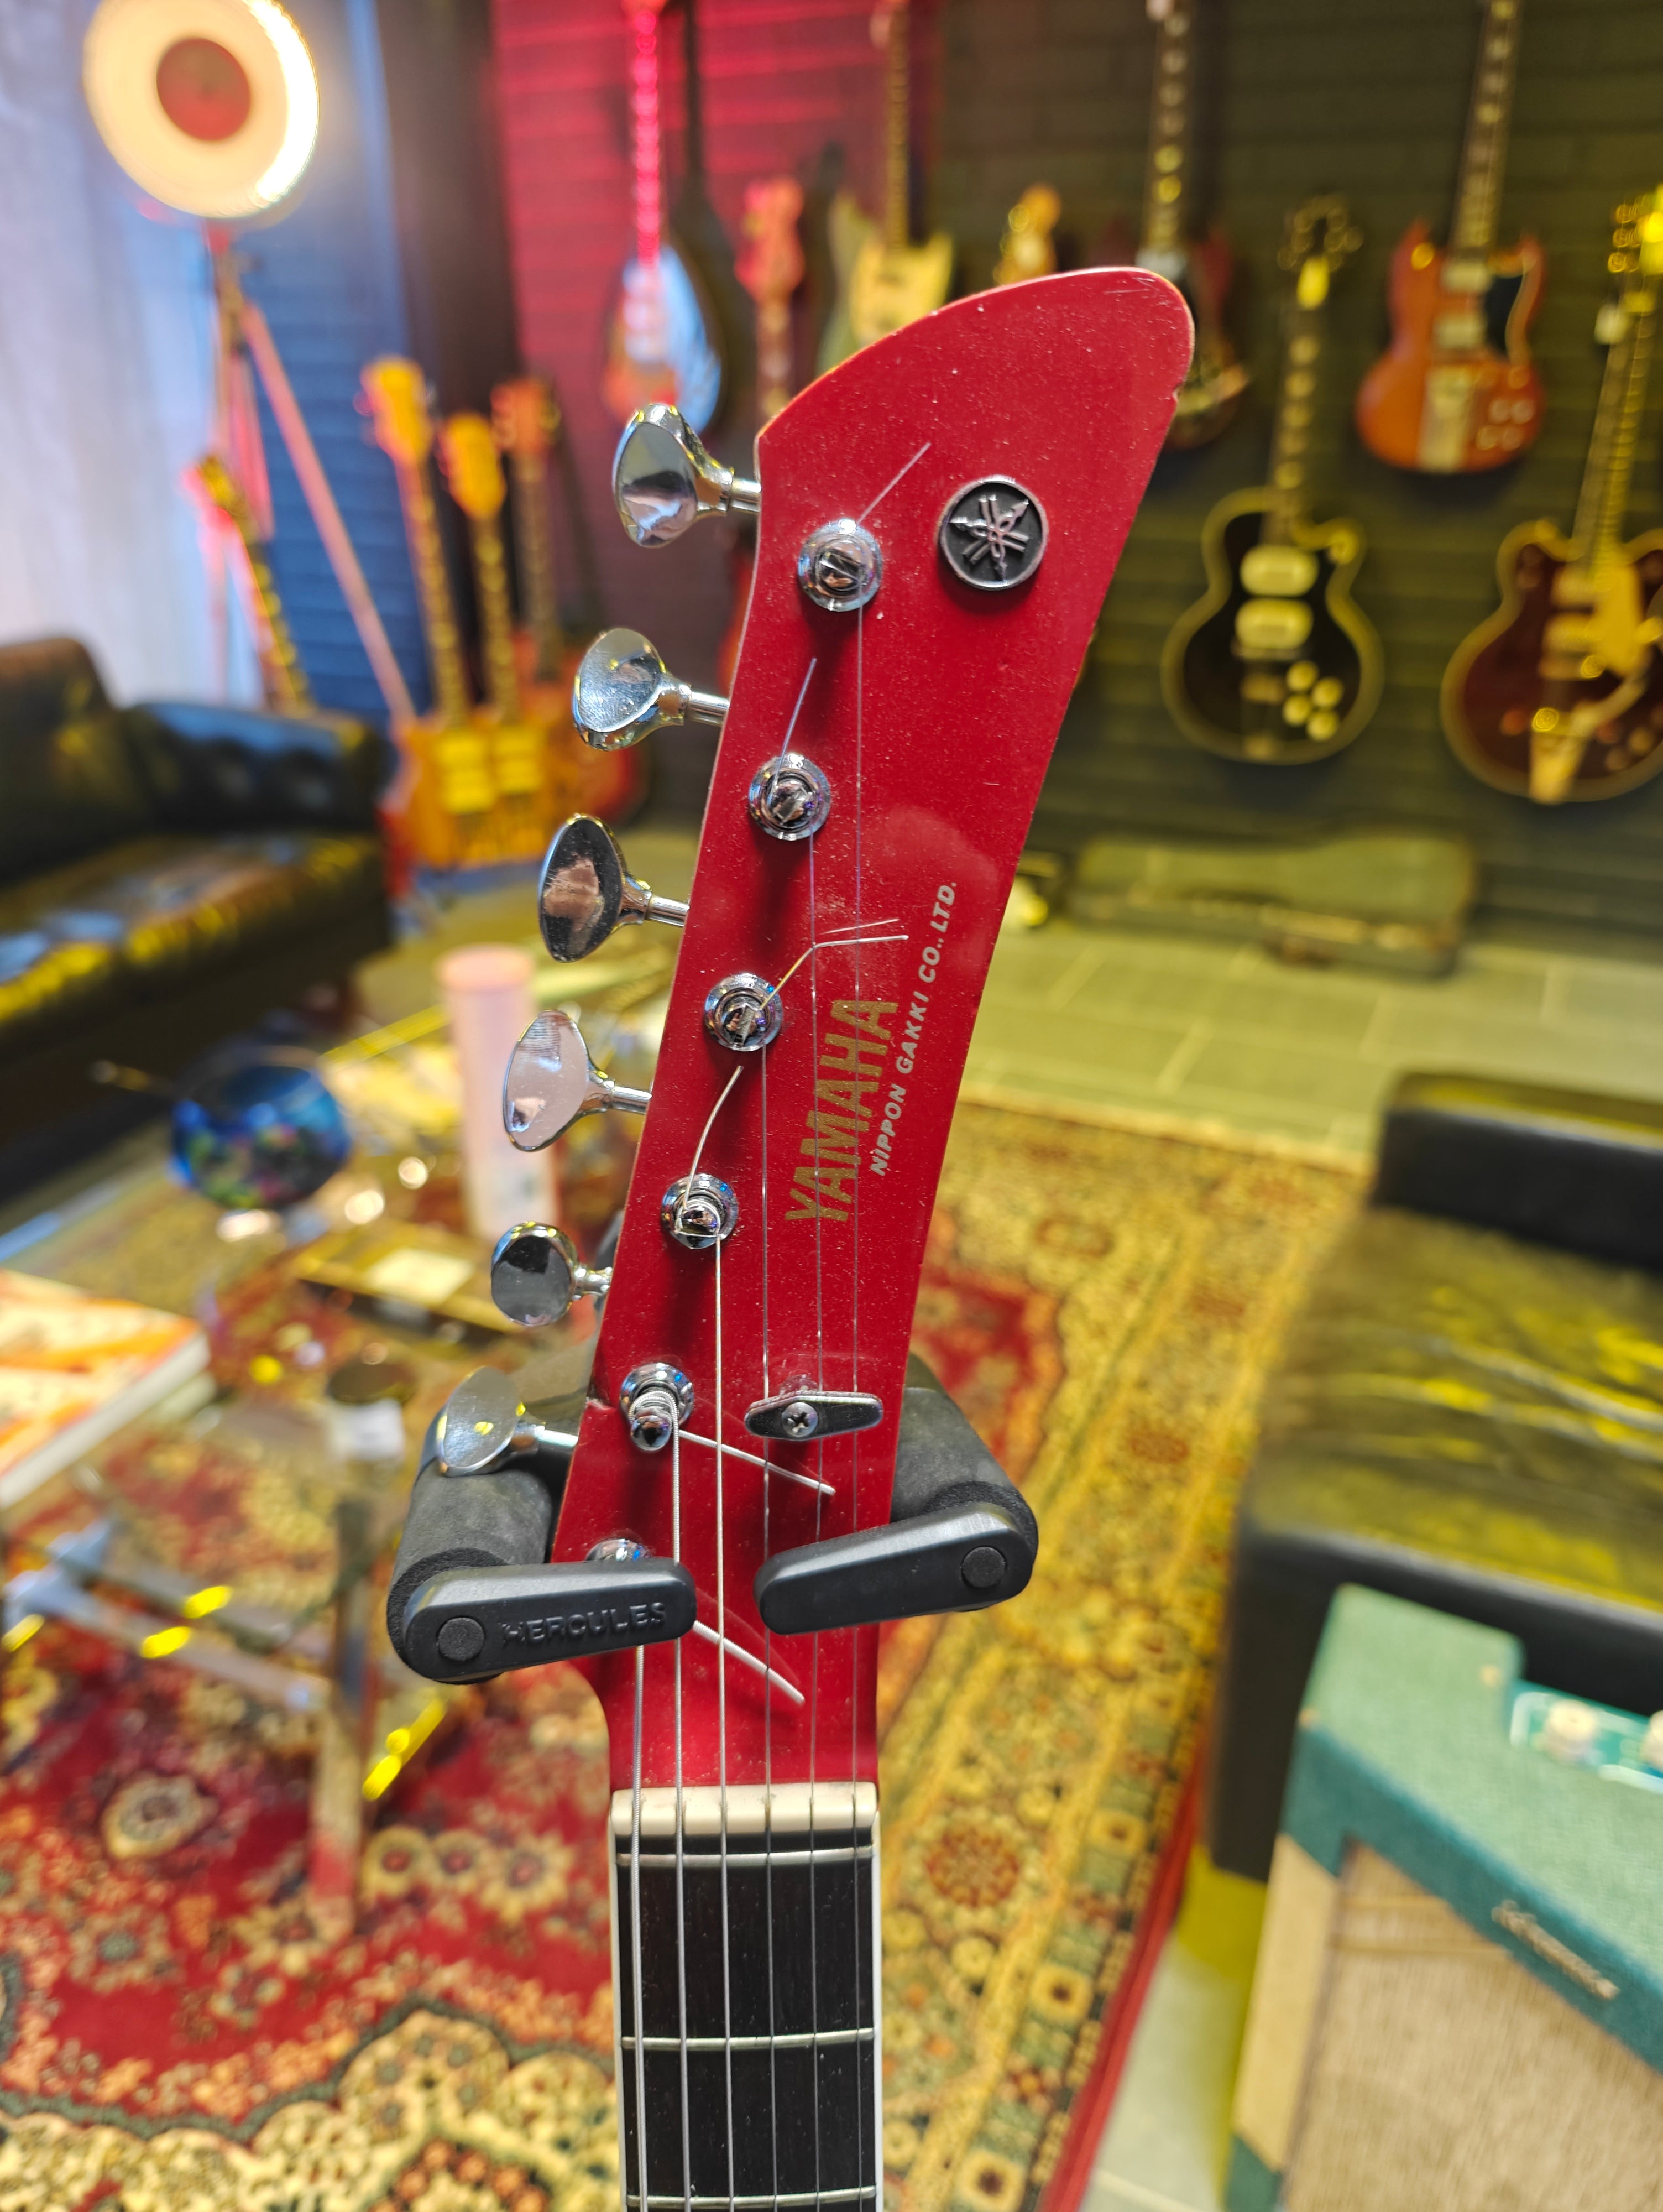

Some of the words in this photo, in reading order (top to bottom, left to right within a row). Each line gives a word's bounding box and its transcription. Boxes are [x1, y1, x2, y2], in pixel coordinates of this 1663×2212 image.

[929, 882, 957, 933] LTD.
[918, 938, 944, 983] CO.,
[895, 990, 929, 1074] GAKKI
[785, 1000, 898, 1221] YAMAHA
[870, 1083, 907, 1177] NIPPON
[498, 1601, 667, 1645] HERCULES
